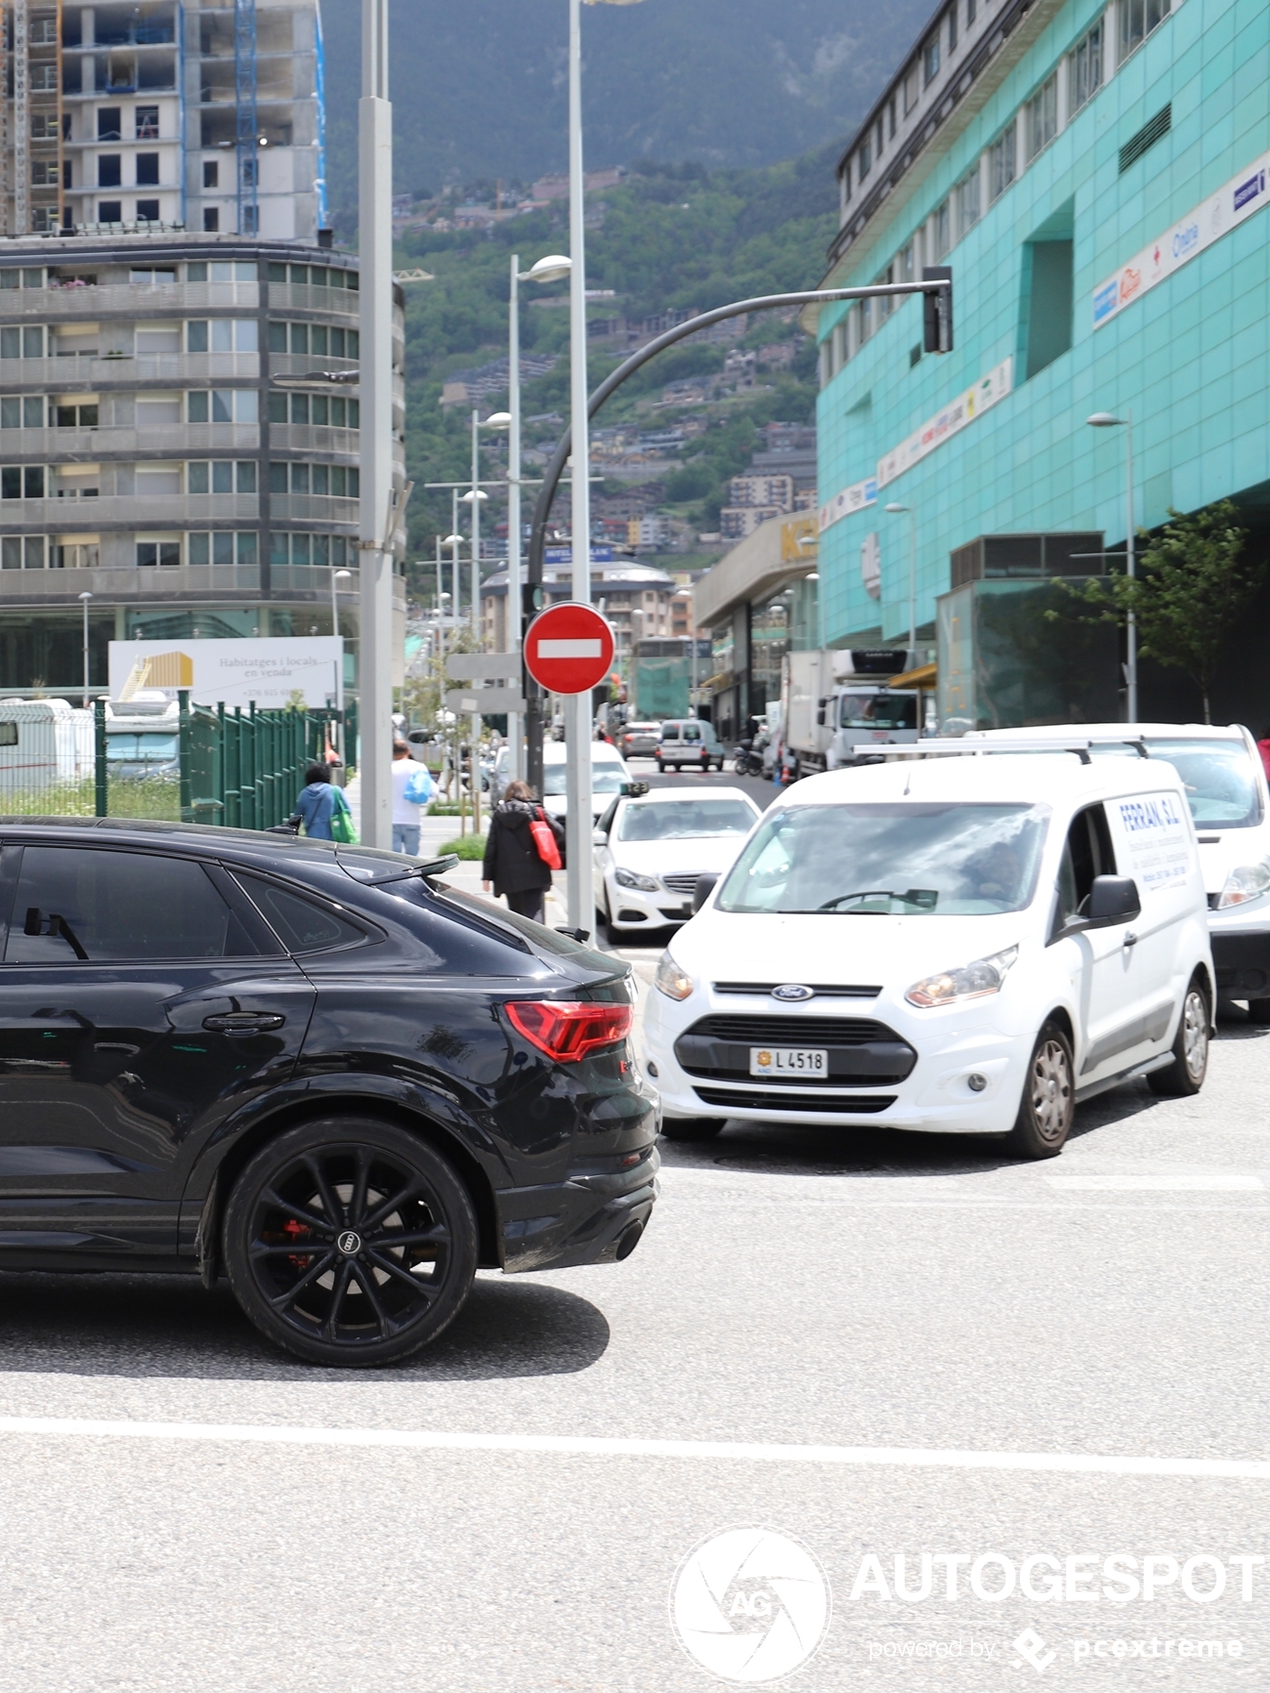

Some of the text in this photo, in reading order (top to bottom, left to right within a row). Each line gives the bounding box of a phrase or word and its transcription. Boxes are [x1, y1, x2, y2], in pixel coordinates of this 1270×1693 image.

[219, 657, 277, 669] Habitatges
[286, 657, 318, 666] locals
[260, 668, 292, 677] venda
[776, 1052, 822, 1069] L 4518
